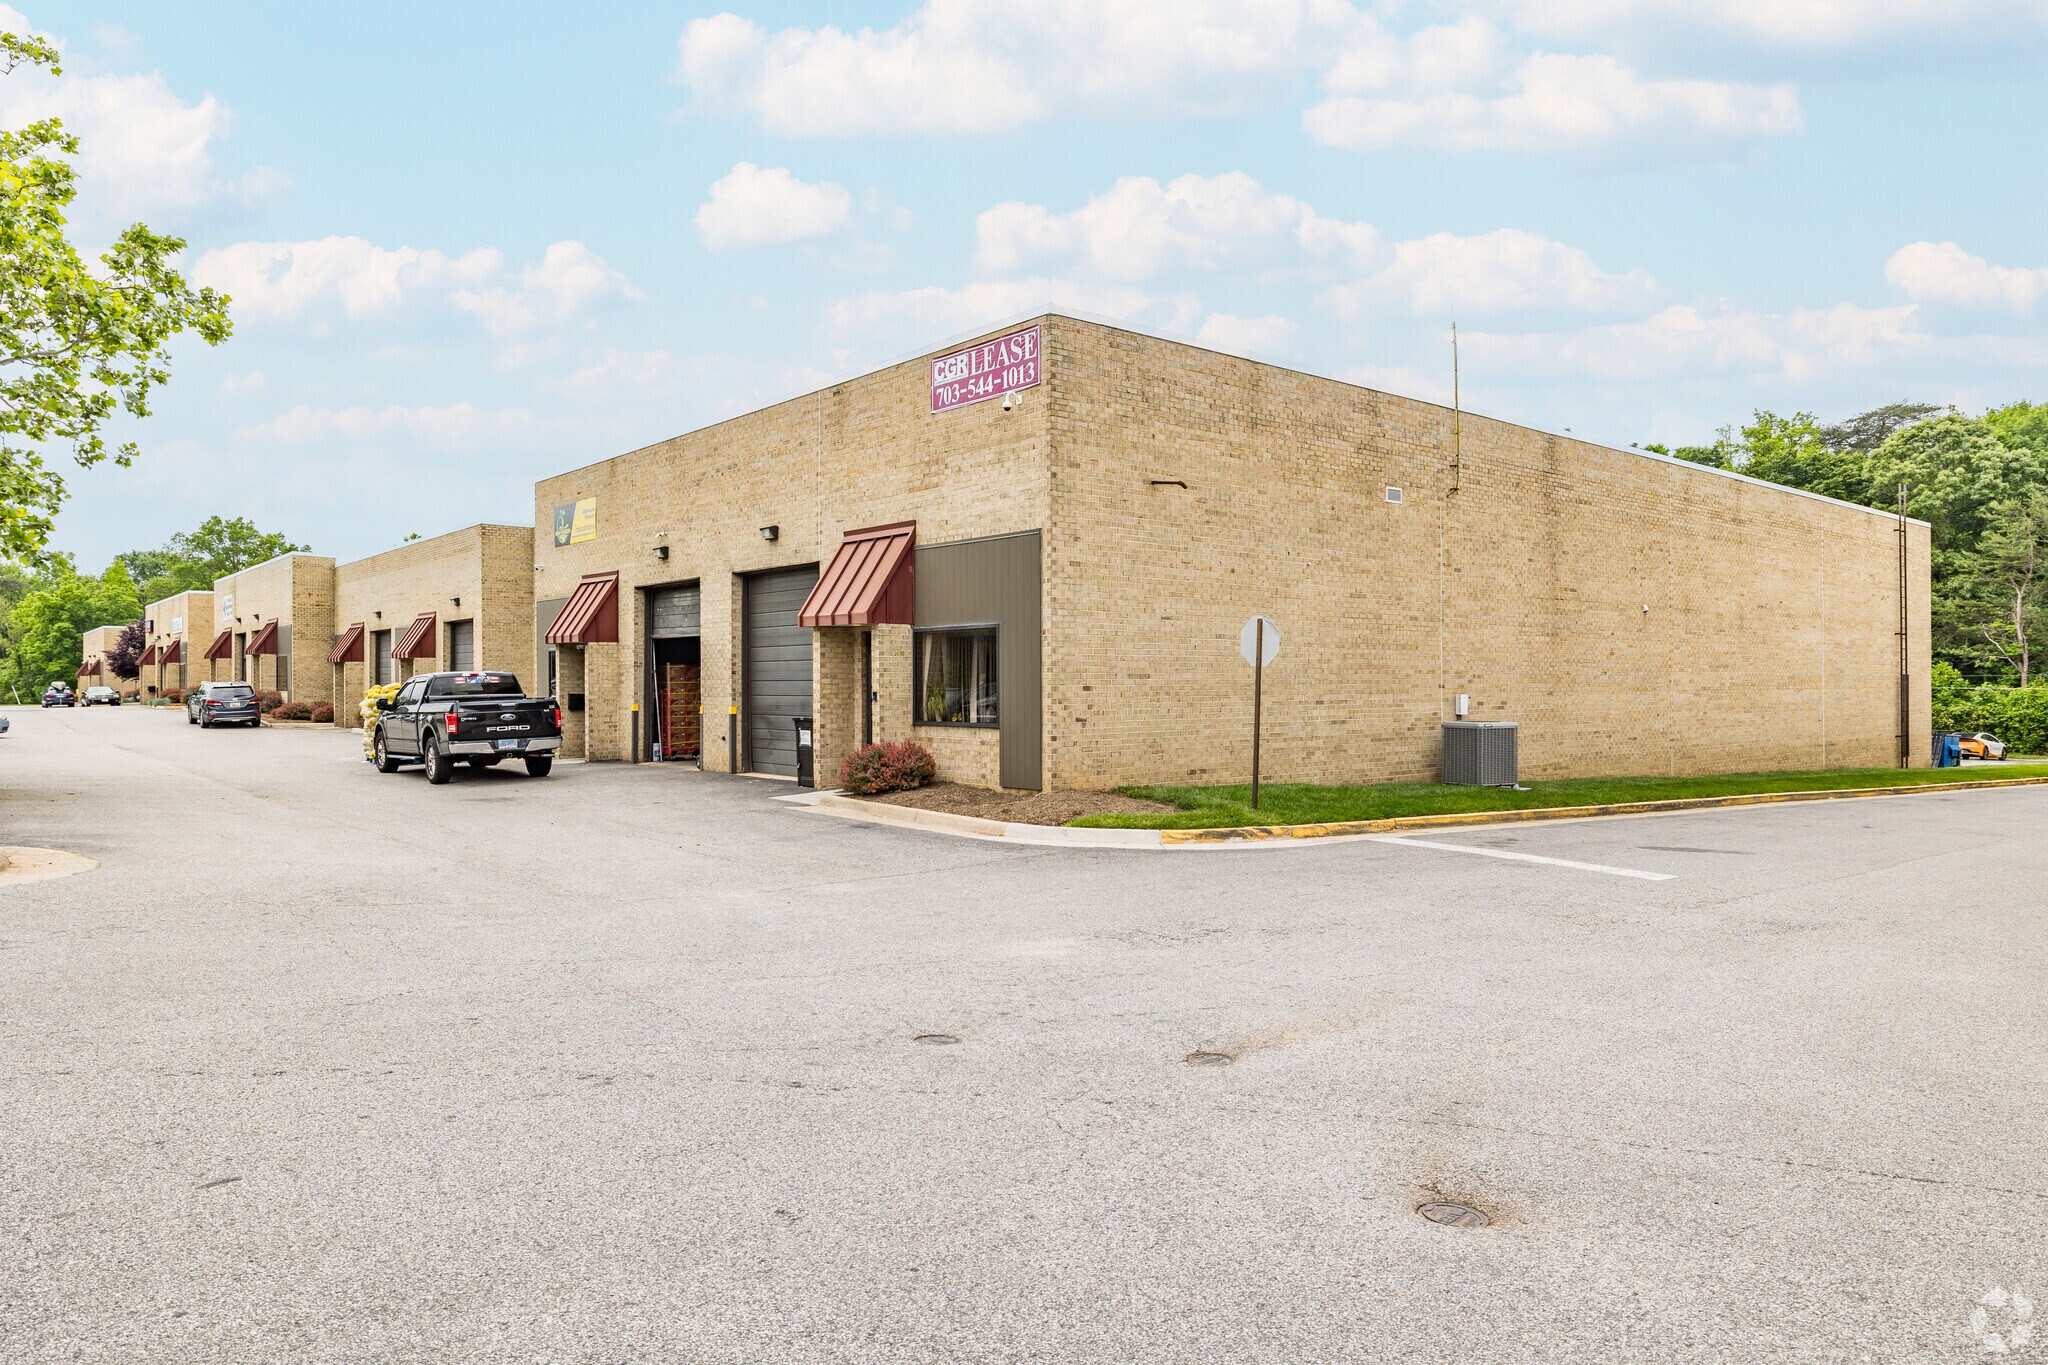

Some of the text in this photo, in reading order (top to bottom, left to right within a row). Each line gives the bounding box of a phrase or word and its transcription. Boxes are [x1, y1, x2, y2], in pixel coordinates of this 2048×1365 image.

[935, 331, 1037, 380] CGR LEASE
[936, 362, 1035, 406] 703-544-1013
